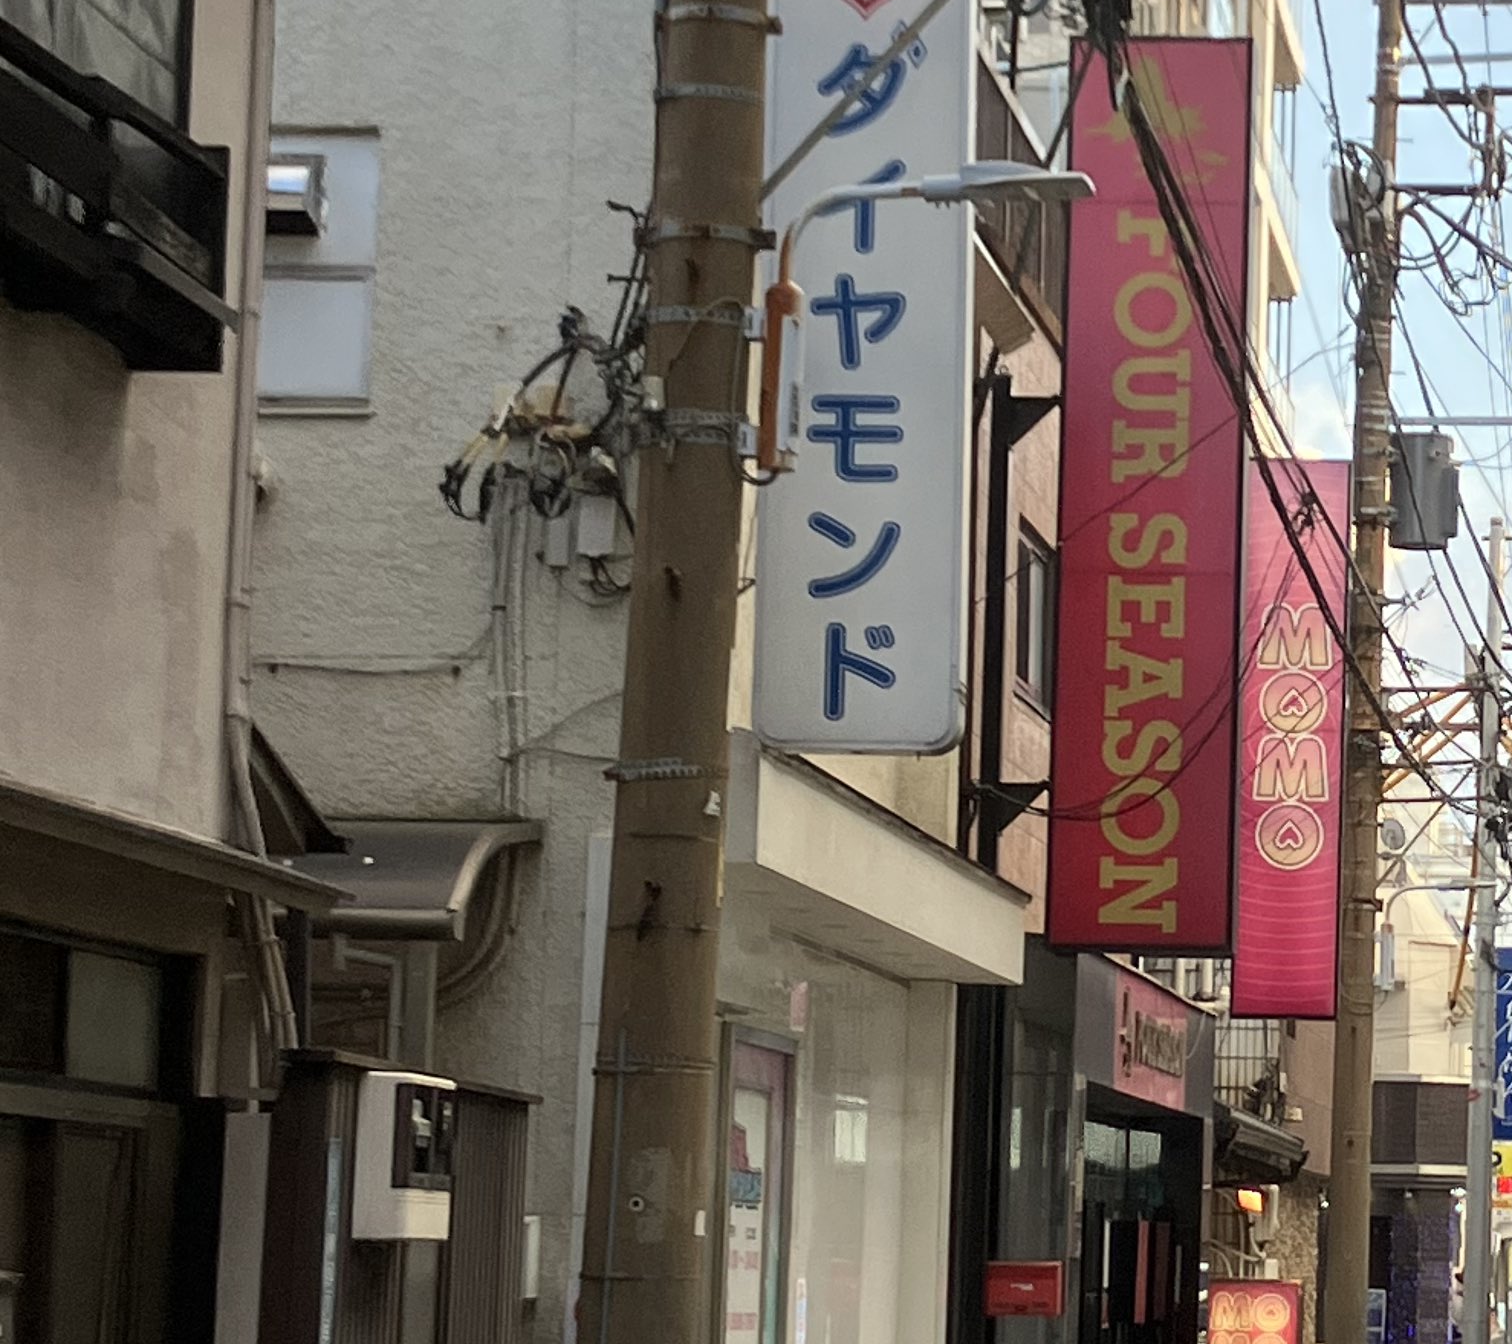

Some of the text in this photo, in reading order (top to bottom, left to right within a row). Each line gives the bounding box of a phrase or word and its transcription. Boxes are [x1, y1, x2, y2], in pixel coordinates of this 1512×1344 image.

[806, 22, 927, 721] ダイヤモンド
[1110, 208, 1193, 483] FOUR
[1098, 514, 1190, 933] SEASON
[1252, 602, 1333, 871] MOMO
